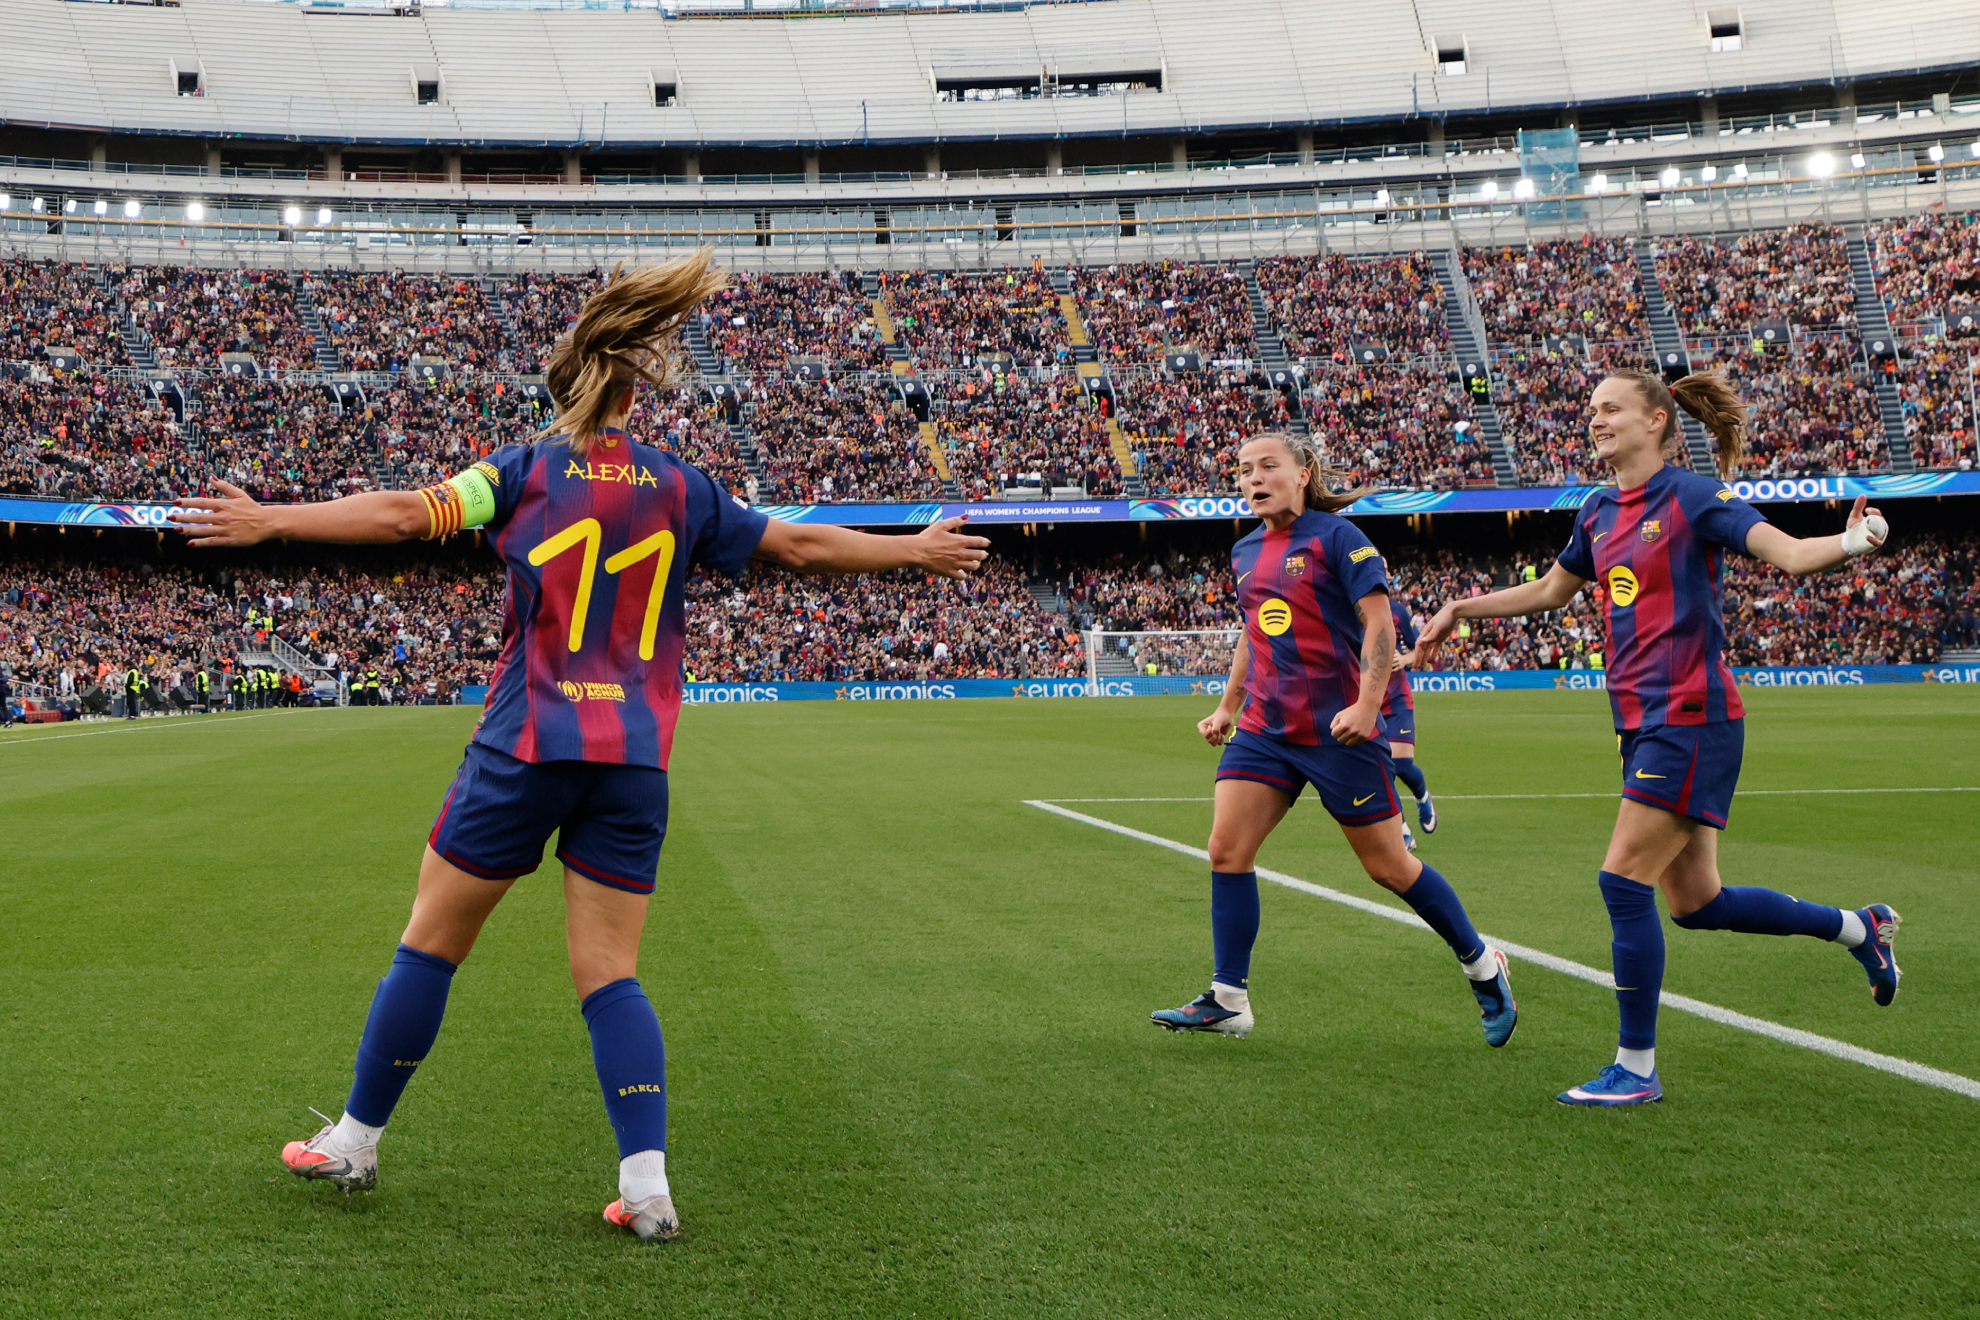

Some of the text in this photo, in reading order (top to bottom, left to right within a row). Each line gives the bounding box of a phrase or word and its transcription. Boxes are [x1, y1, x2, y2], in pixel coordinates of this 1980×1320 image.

[564, 459, 657, 488] ALEXIA
[461, 476, 483, 506] RESPECT
[1723, 478, 1844, 500] OOOOL!
[984, 508, 1020, 516] WOMEN'S
[1022, 507, 1069, 515] CHAMPIONS
[1071, 506, 1101, 514] LEAGUE
[528, 518, 675, 661] 11
[1753, 665, 1863, 686] euronics
[582, 682, 623, 691] UNHCR
[586, 689, 626, 699] ACNUR
[850, 680, 956, 700] euronics
